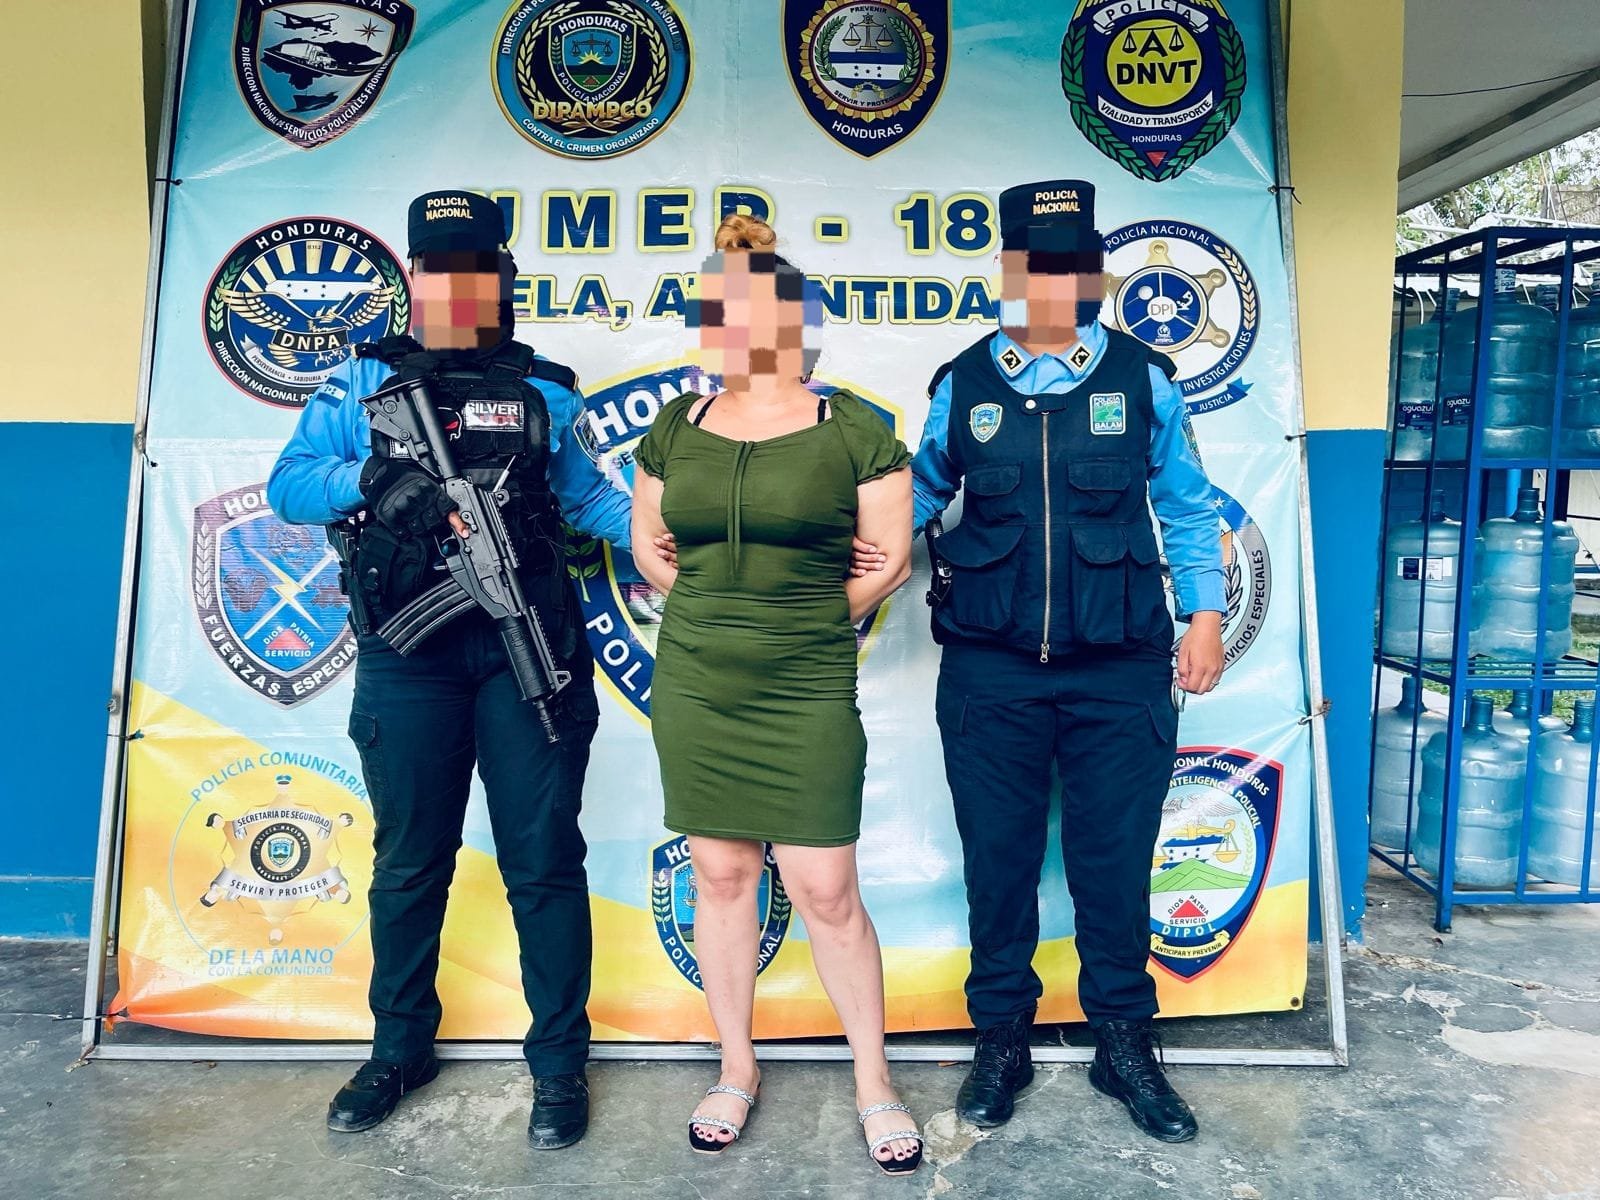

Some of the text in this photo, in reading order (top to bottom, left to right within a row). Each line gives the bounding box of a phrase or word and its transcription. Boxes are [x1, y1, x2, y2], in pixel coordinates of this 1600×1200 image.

[850, 6, 888, 14] PREVENIR
[558, 16, 628, 34] HONDURAS
[1116, 60, 1197, 85] DNVT
[591, 71, 627, 102] NACIONAL
[833, 90, 858, 105] SERVIR
[253, 92, 279, 124] NACIONAL
[283, 123, 327, 140] SERVICIOS
[328, 93, 368, 131] POLICIALES
[533, 100, 652, 120] DIPAMPCO
[1100, 100, 1212, 126] VIALIDAD Y TRANSPORTE
[522, 117, 659, 152] CONTRA EL CRIMEN ORGANIZADO
[832, 121, 904, 139] HONDURAS
[1132, 134, 1182, 143] HONDURAS
[427, 197, 470, 208] POLICIA
[1035, 190, 1078, 201] POLICIA
[425, 208, 473, 221] NACIONAL
[1032, 202, 1080, 215] NACIONAL
[894, 191, 999, 257] 18
[255, 222, 373, 250] HONDURAS
[1151, 225, 1210, 246] NACIONAL
[1150, 304, 1174, 316] DPI
[281, 333, 341, 350] DNPA
[251, 354, 322, 382] PERSEVERANCIA SABIDURIA
[1183, 331, 1252, 391] INVESTIGACIONES
[215, 341, 248, 383] DIRECCIÓN
[249, 378, 298, 401] NACIONAL
[464, 402, 518, 415] SILVER
[1199, 394, 1234, 412] JUSTICIA
[1447, 398, 1471, 407] aguazu
[1251, 549, 1265, 620] ESPECIALES
[263, 622, 315, 647] DIOS PATRIA
[204, 614, 358, 696] FUERZAS ESPECIA
[259, 751, 368, 801] COMUNITARIA
[1212, 758, 1270, 796] HONDURAS
[1169, 776, 1262, 829] NTELIGENCIA POLICIAL
[237, 810, 330, 827] SECRETARIA DE SEGURIDAD
[230, 878, 329, 896] SERVIR Y PROTEGER
[1168, 895, 1209, 915] DIOS PATRIA
[1161, 923, 1217, 937] DIPOL
[208, 948, 334, 966] DE LA MANO
[1154, 946, 1186, 956] ANTICIPAR
[1192, 943, 1223, 956] PREVENIR
[208, 965, 333, 976] CON LA COMUNIDAD
